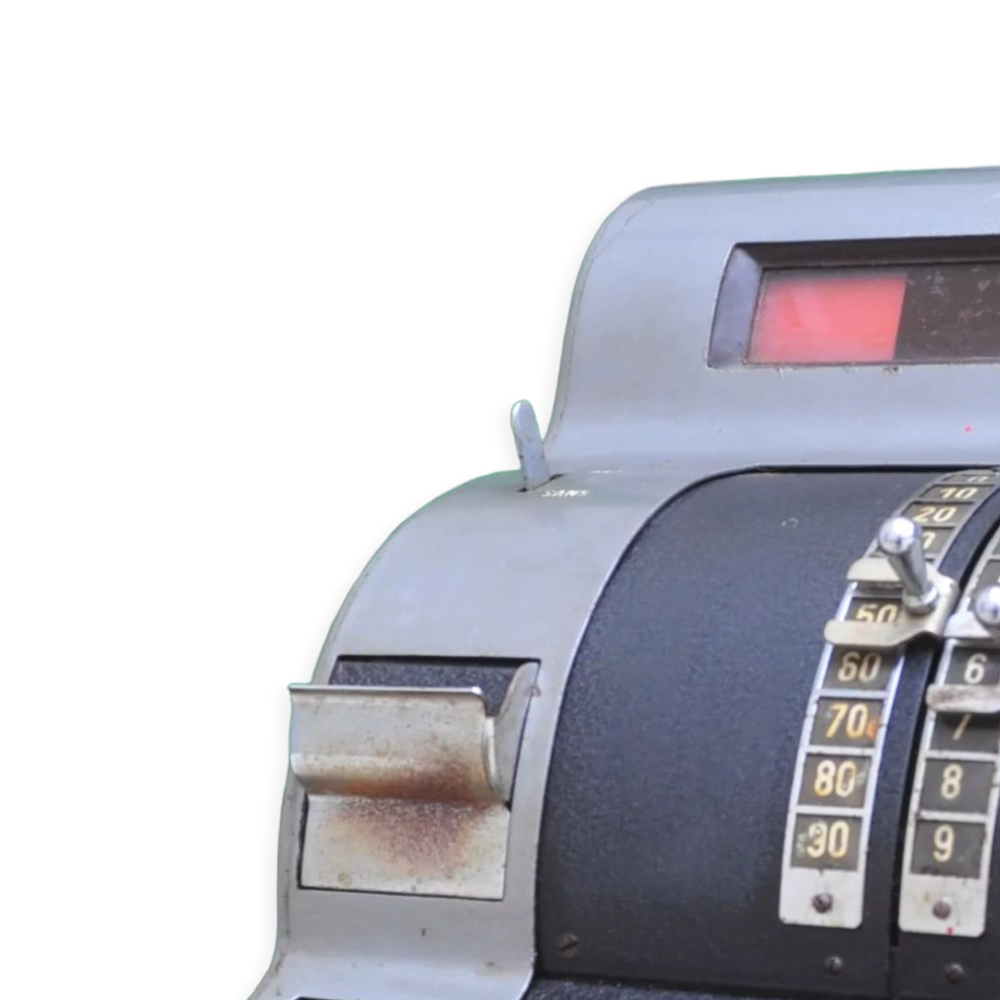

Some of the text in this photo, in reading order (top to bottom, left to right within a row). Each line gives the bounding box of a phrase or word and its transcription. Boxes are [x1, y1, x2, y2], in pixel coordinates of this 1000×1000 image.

[939, 487, 979, 499] 10
[913, 506, 957, 523] 20
[836, 652, 882, 684] 60
[963, 653, 988, 684] 6
[826, 703, 869, 739] 70
[814, 760, 857, 798] 80
[940, 764, 964, 800] 8
[932, 825, 956, 863] 9
